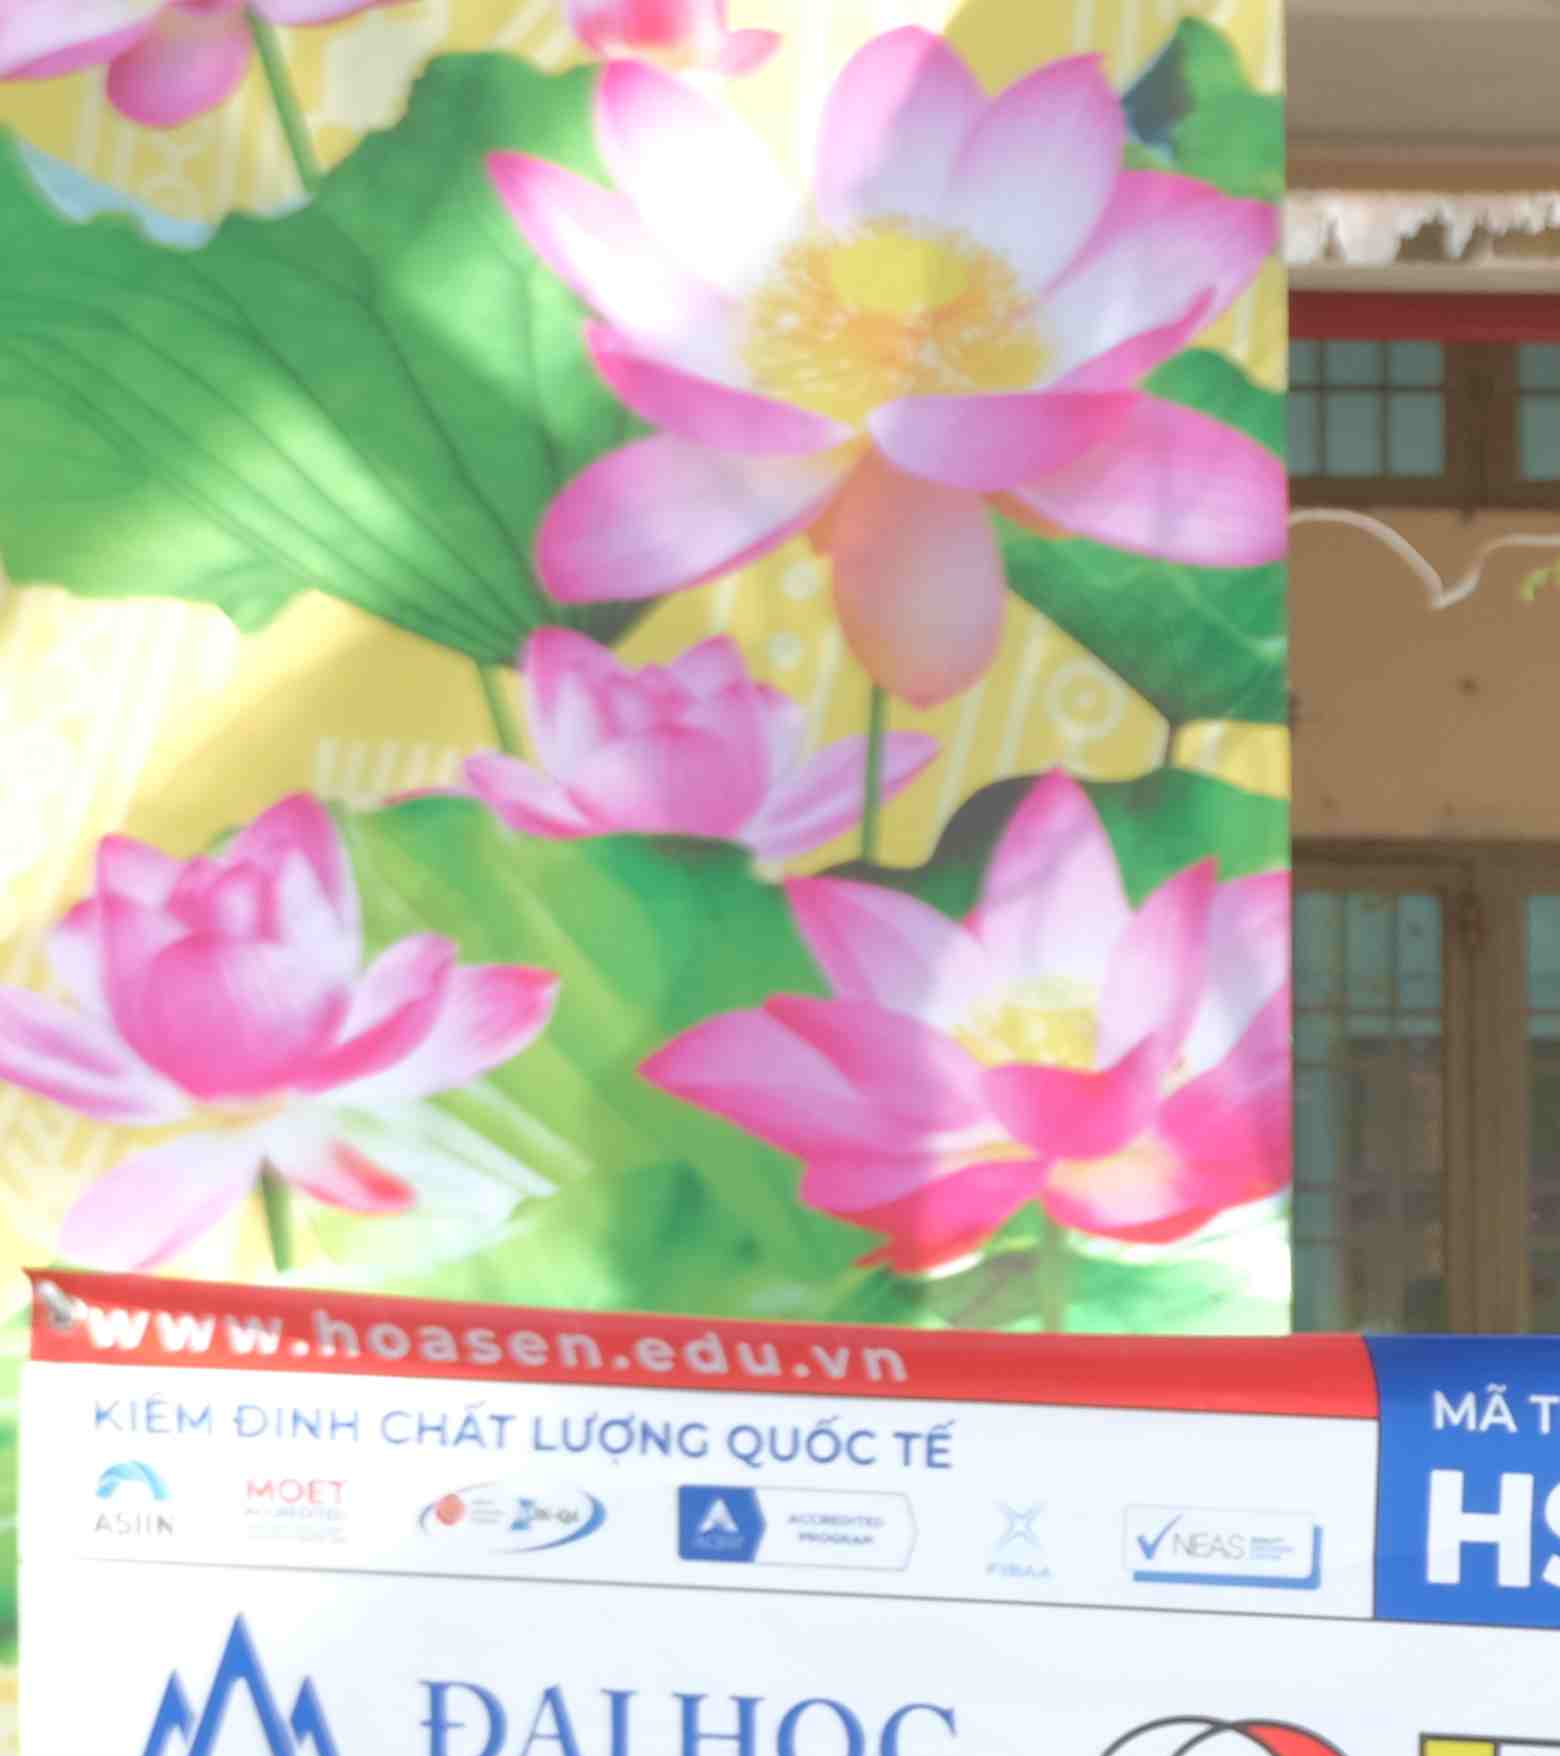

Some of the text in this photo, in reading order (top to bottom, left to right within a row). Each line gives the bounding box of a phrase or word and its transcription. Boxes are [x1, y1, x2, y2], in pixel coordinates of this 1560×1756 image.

[85, 1305, 909, 1383] www.hoasen.edu.vn
[1432, 1383, 1518, 1433] MÃ
[380, 1400, 517, 1451] CHẤT
[533, 1412, 709, 1466] LƯỢNG
[726, 1415, 878, 1469] QUỐC
[892, 1418, 956, 1470] TẾ
[245, 1478, 348, 1505] MOET
[94, 1511, 176, 1537] ASIIN
[1172, 1533, 1248, 1559] NEAS
